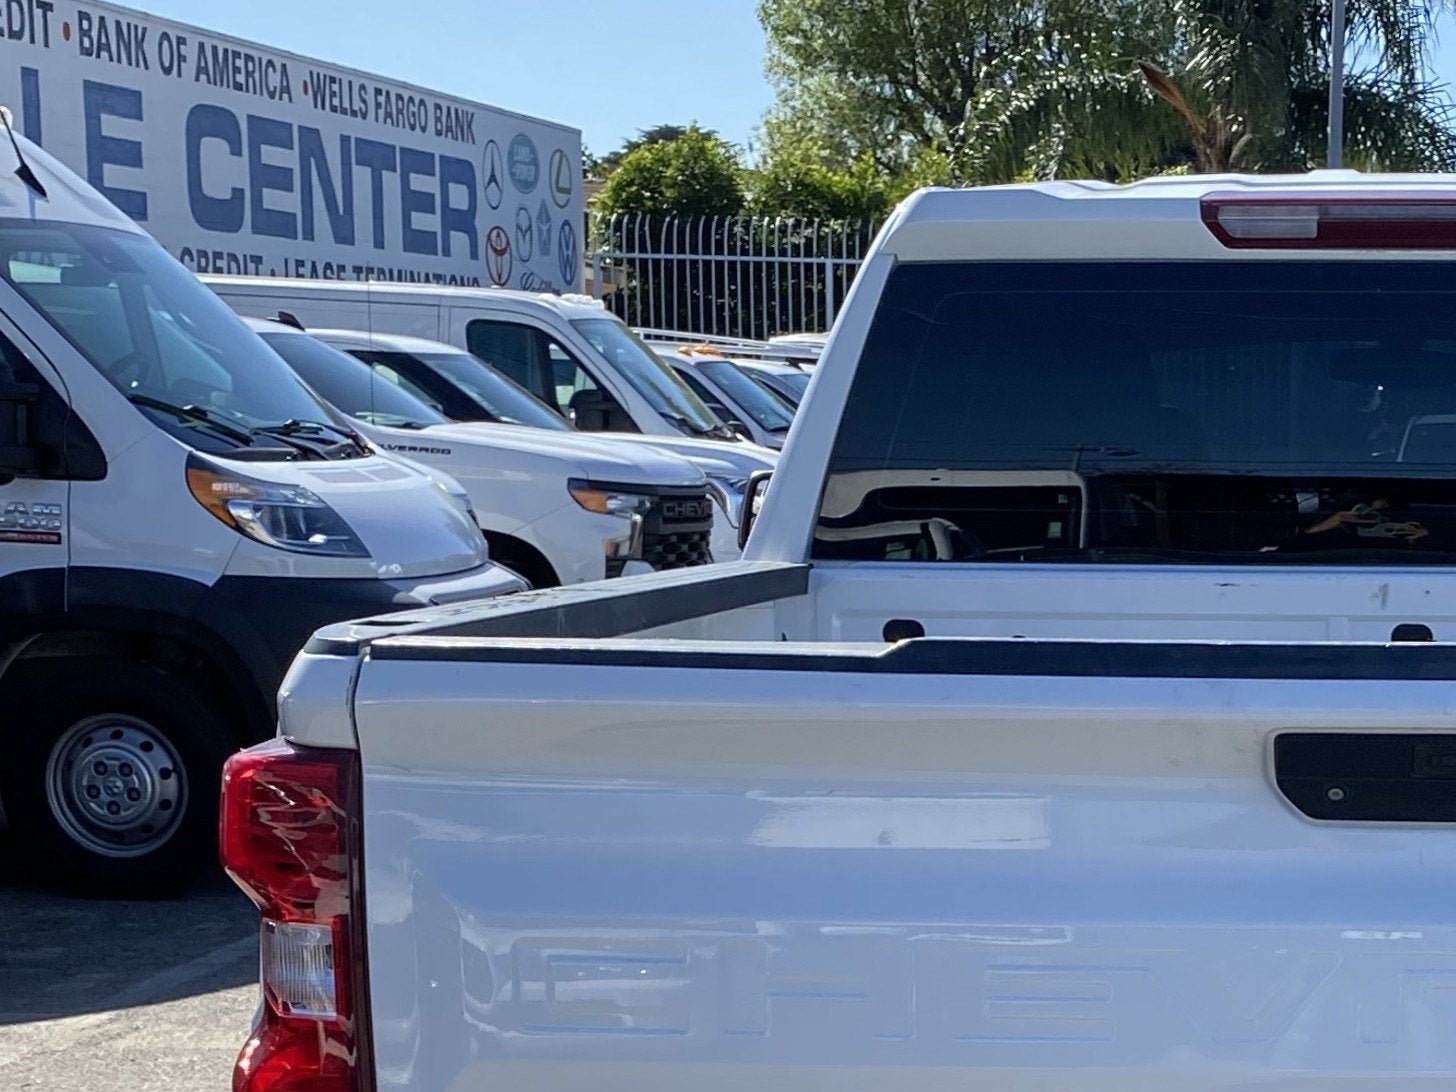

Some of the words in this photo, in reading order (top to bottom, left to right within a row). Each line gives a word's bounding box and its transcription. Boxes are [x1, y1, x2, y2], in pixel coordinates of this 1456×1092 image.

[0, 0, 54, 48] DIT
[77, 10, 149, 71] BANK
[157, 31, 188, 79] OF
[194, 41, 293, 103] AMERICA
[309, 69, 368, 121] WELLS
[374, 86, 428, 134] FARGO
[433, 102, 476, 145] BANK
[185, 103, 480, 261] CENTER
[376, 443, 451, 455] LVERADO
[3, 501, 62, 517] AM
